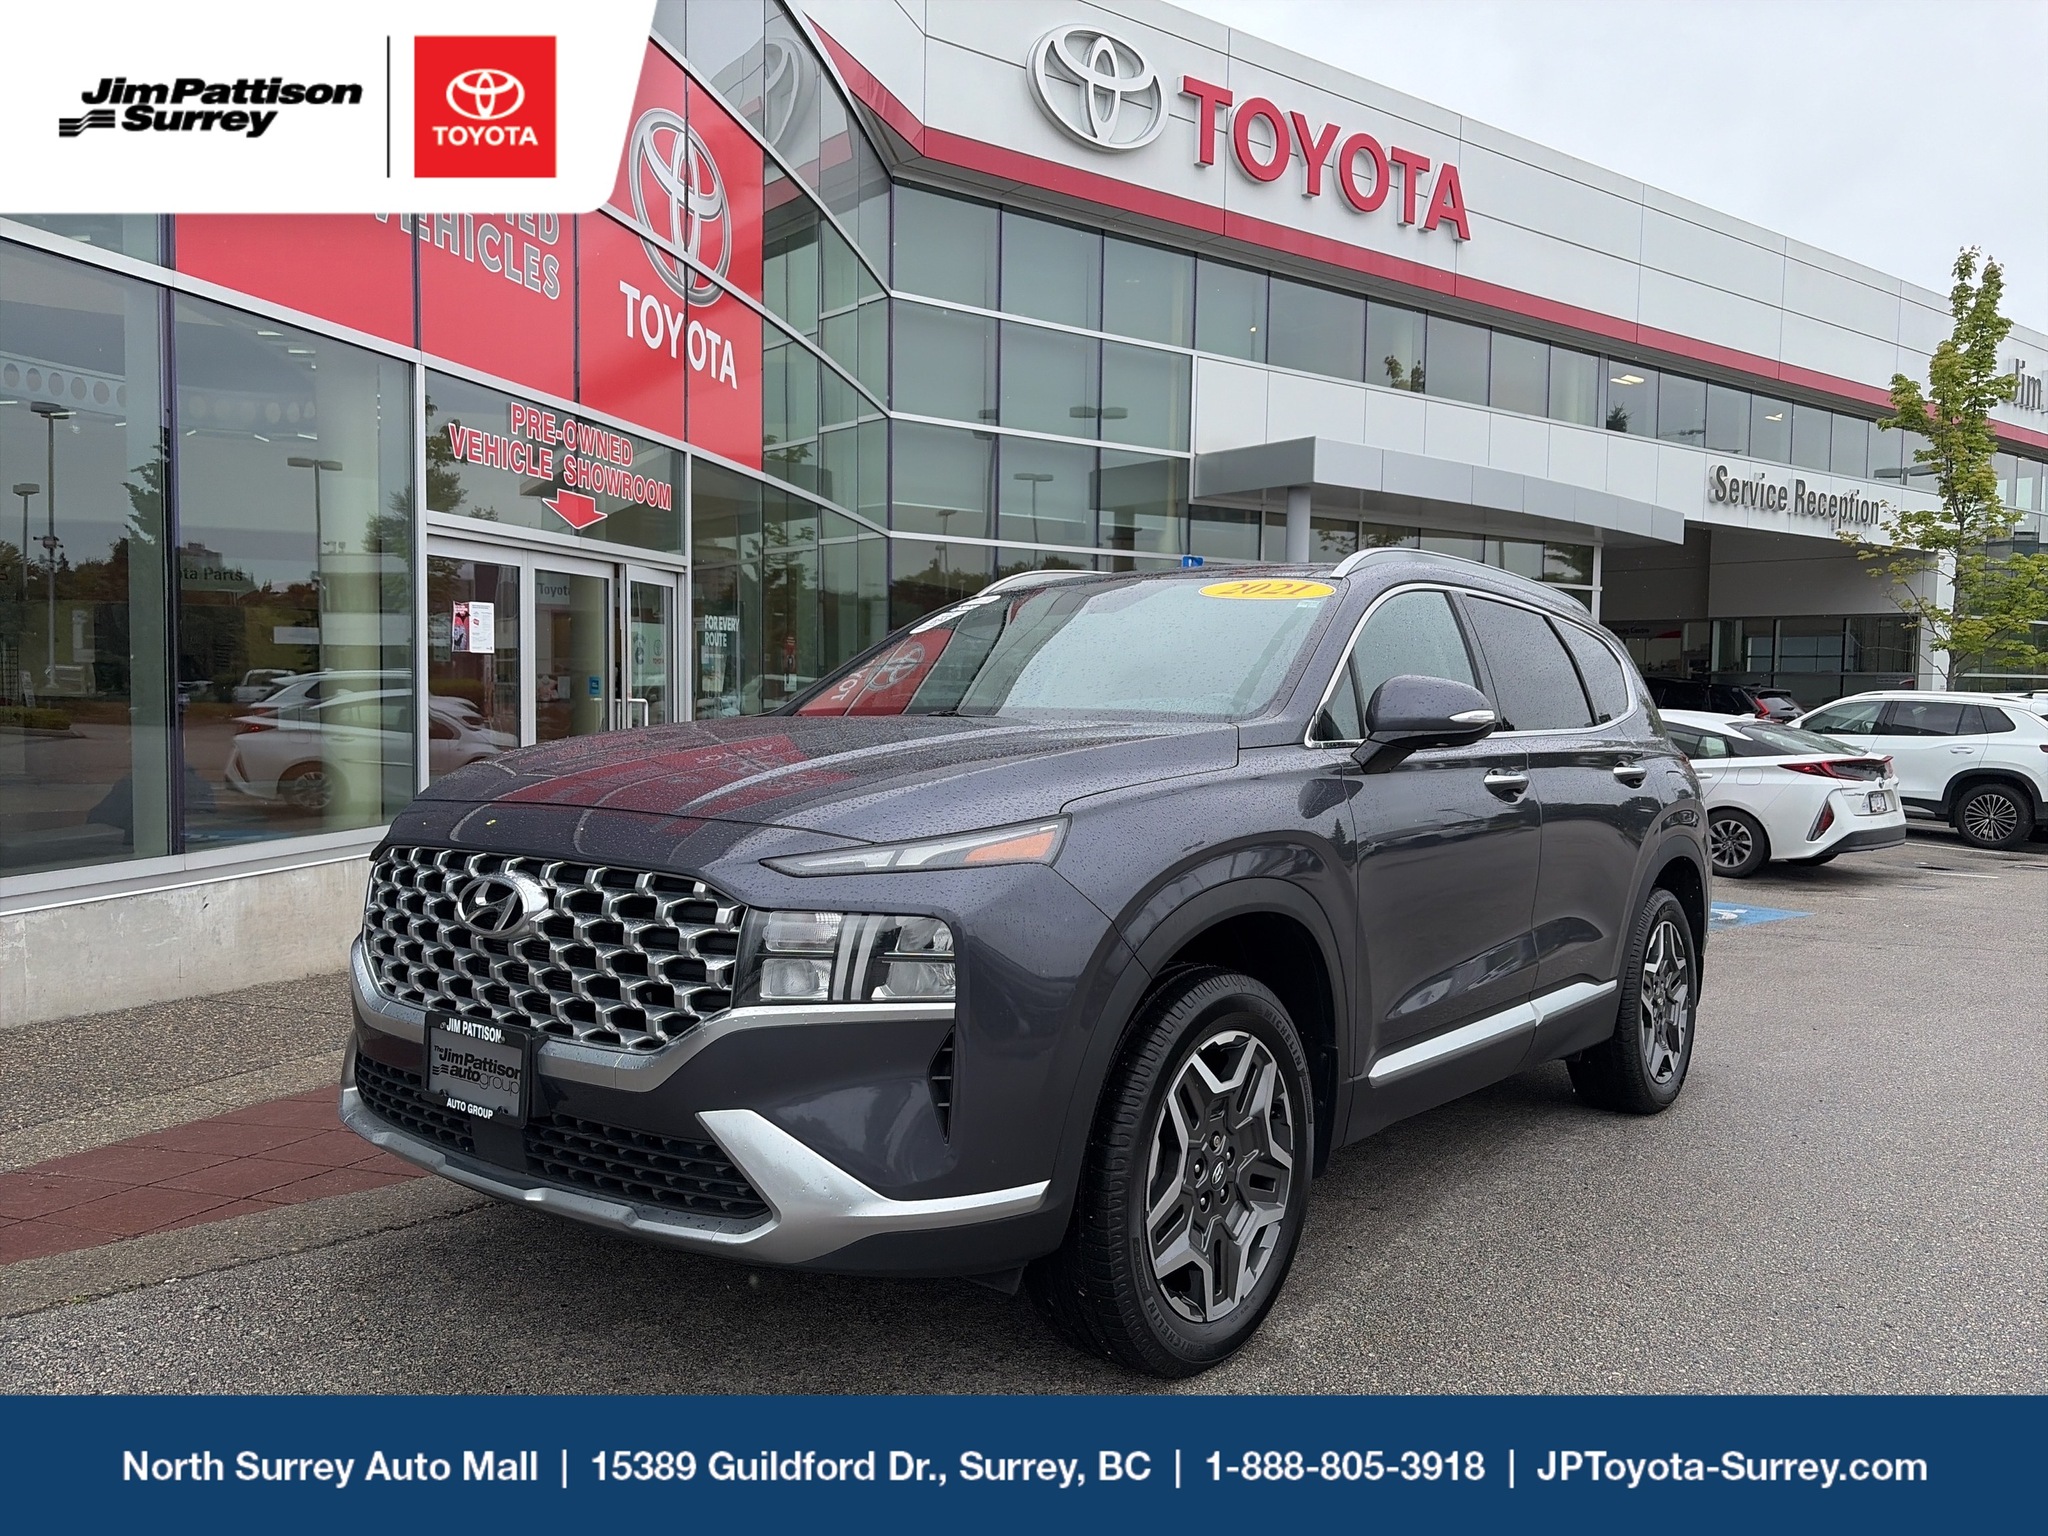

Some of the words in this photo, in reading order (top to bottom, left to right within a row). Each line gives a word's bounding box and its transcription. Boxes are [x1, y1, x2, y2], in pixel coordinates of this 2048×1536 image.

[1177, 75, 1470, 242] TOYOTA
[619, 281, 738, 390] TOYOTA
[510, 402, 634, 467] PRE-OWNED
[448, 423, 554, 481] VEHICLE
[563, 454, 673, 512] SHOWROOM
[1713, 465, 1788, 512] Service
[1793, 478, 1880, 529] Reception
[204, 567, 243, 581] Parts
[536, 582, 570, 598] Toyot
[1217, 583, 1313, 595] 2021
[704, 614, 718, 630] FOR
[719, 616, 740, 632] EVERY
[704, 631, 728, 648] ROUTE
[446, 1017, 461, 1035] JIM
[462, 1020, 502, 1044] PATTISON
[446, 1097, 467, 1112] AUTO
[467, 1103, 494, 1120] GROUP
